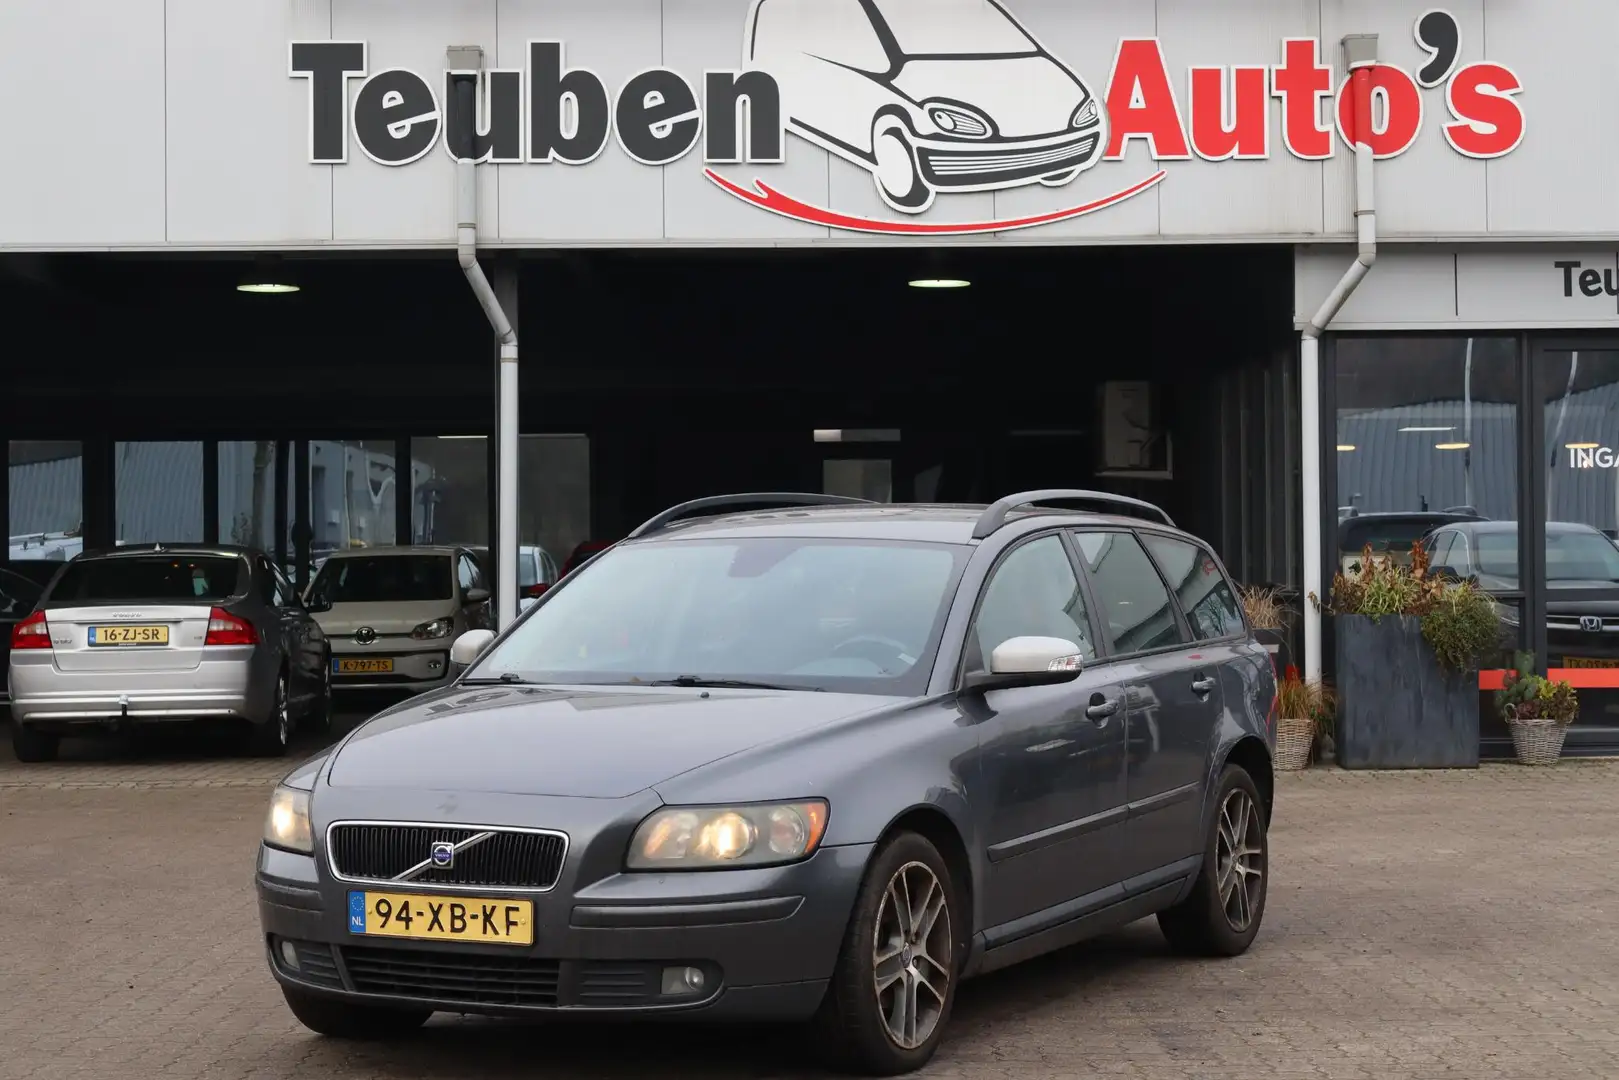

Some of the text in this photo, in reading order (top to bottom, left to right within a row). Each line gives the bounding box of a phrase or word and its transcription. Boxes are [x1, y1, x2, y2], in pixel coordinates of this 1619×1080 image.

[290, 10, 1524, 164] Teuben Auto's
[103, 628, 160, 641] 16-ZJ-SR
[343, 660, 389, 671] K-797-TS
[351, 915, 364, 926] NL
[375, 898, 521, 936] 94-XB-KF
